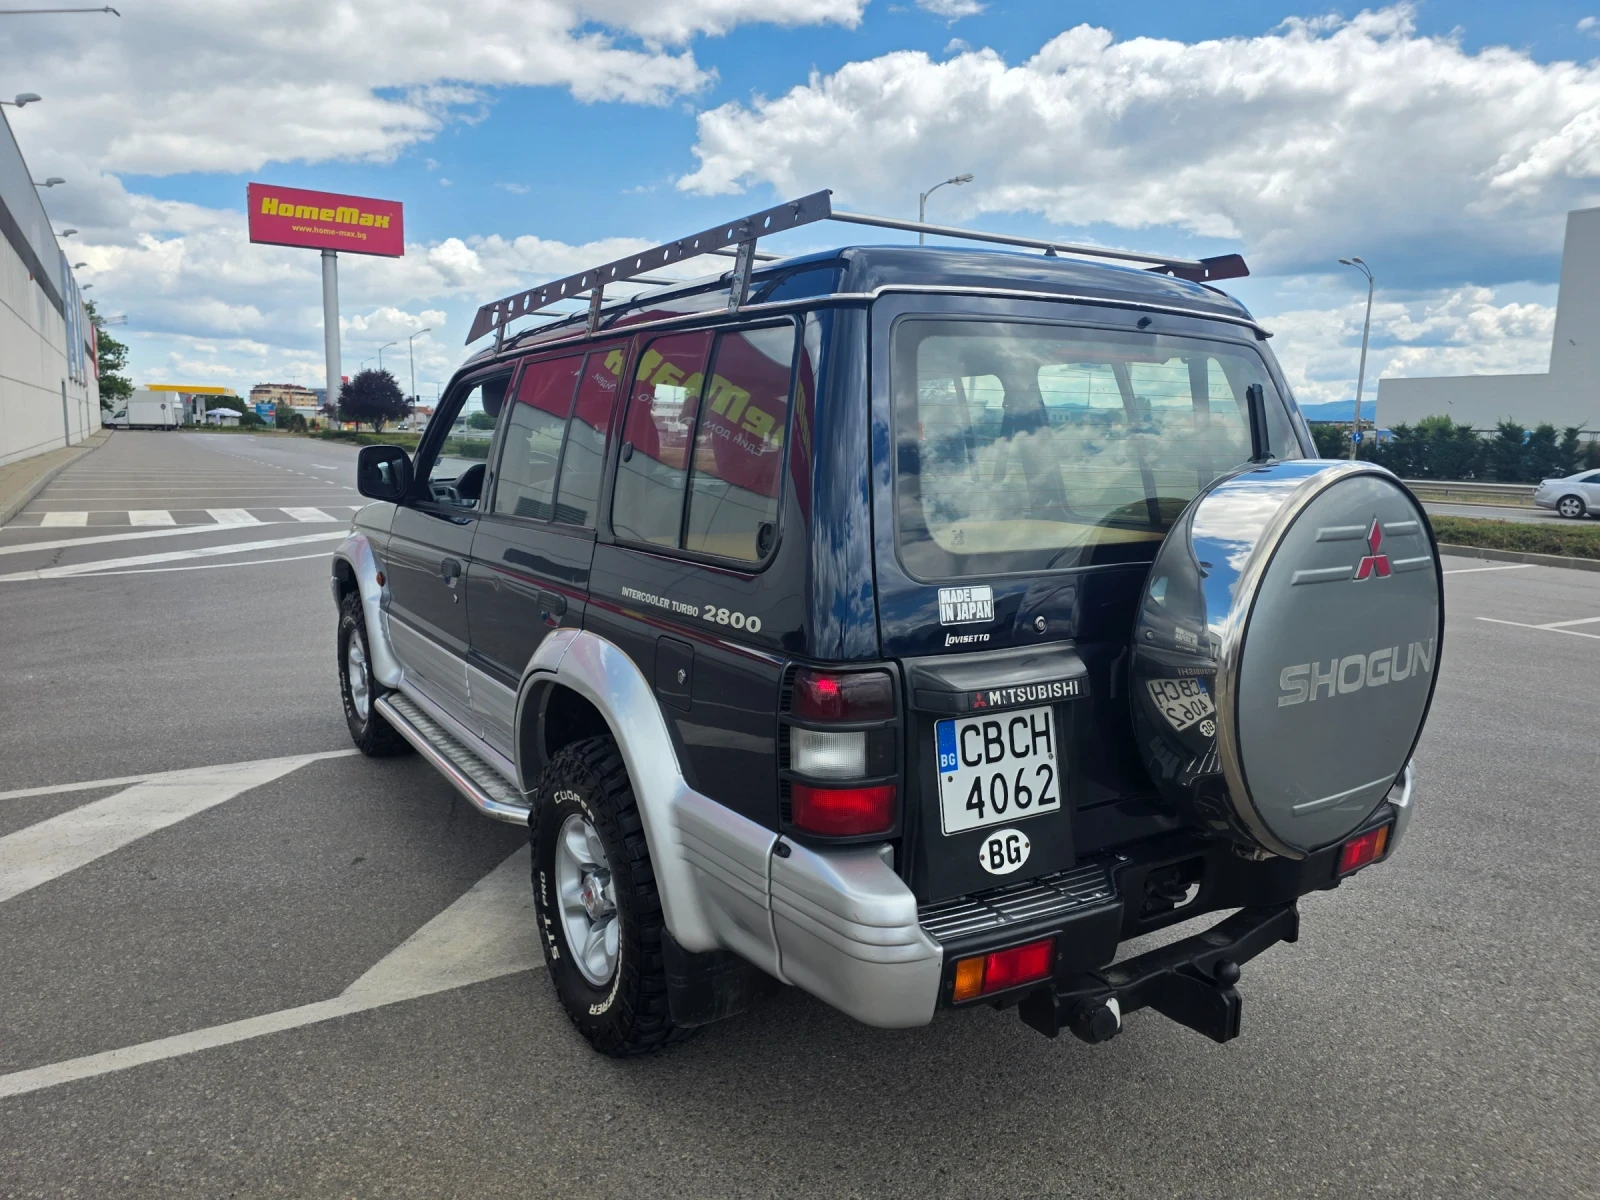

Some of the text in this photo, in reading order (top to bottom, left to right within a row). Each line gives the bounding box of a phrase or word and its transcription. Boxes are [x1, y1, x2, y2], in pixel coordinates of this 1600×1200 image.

[261, 197, 391, 228] HomeMax
[292, 225, 367, 240] www.home-max.bg
[621, 586, 762, 633] INTERCOOLER TURBO 2800
[940, 588, 971, 604] MADE
[941, 600, 992, 622] IN JAPAN
[1277, 637, 1434, 708] SHOGUN
[960, 712, 1051, 767] CBCH
[941, 753, 956, 767] BG
[966, 764, 1056, 819] 4062
[988, 834, 1021, 869] BG
